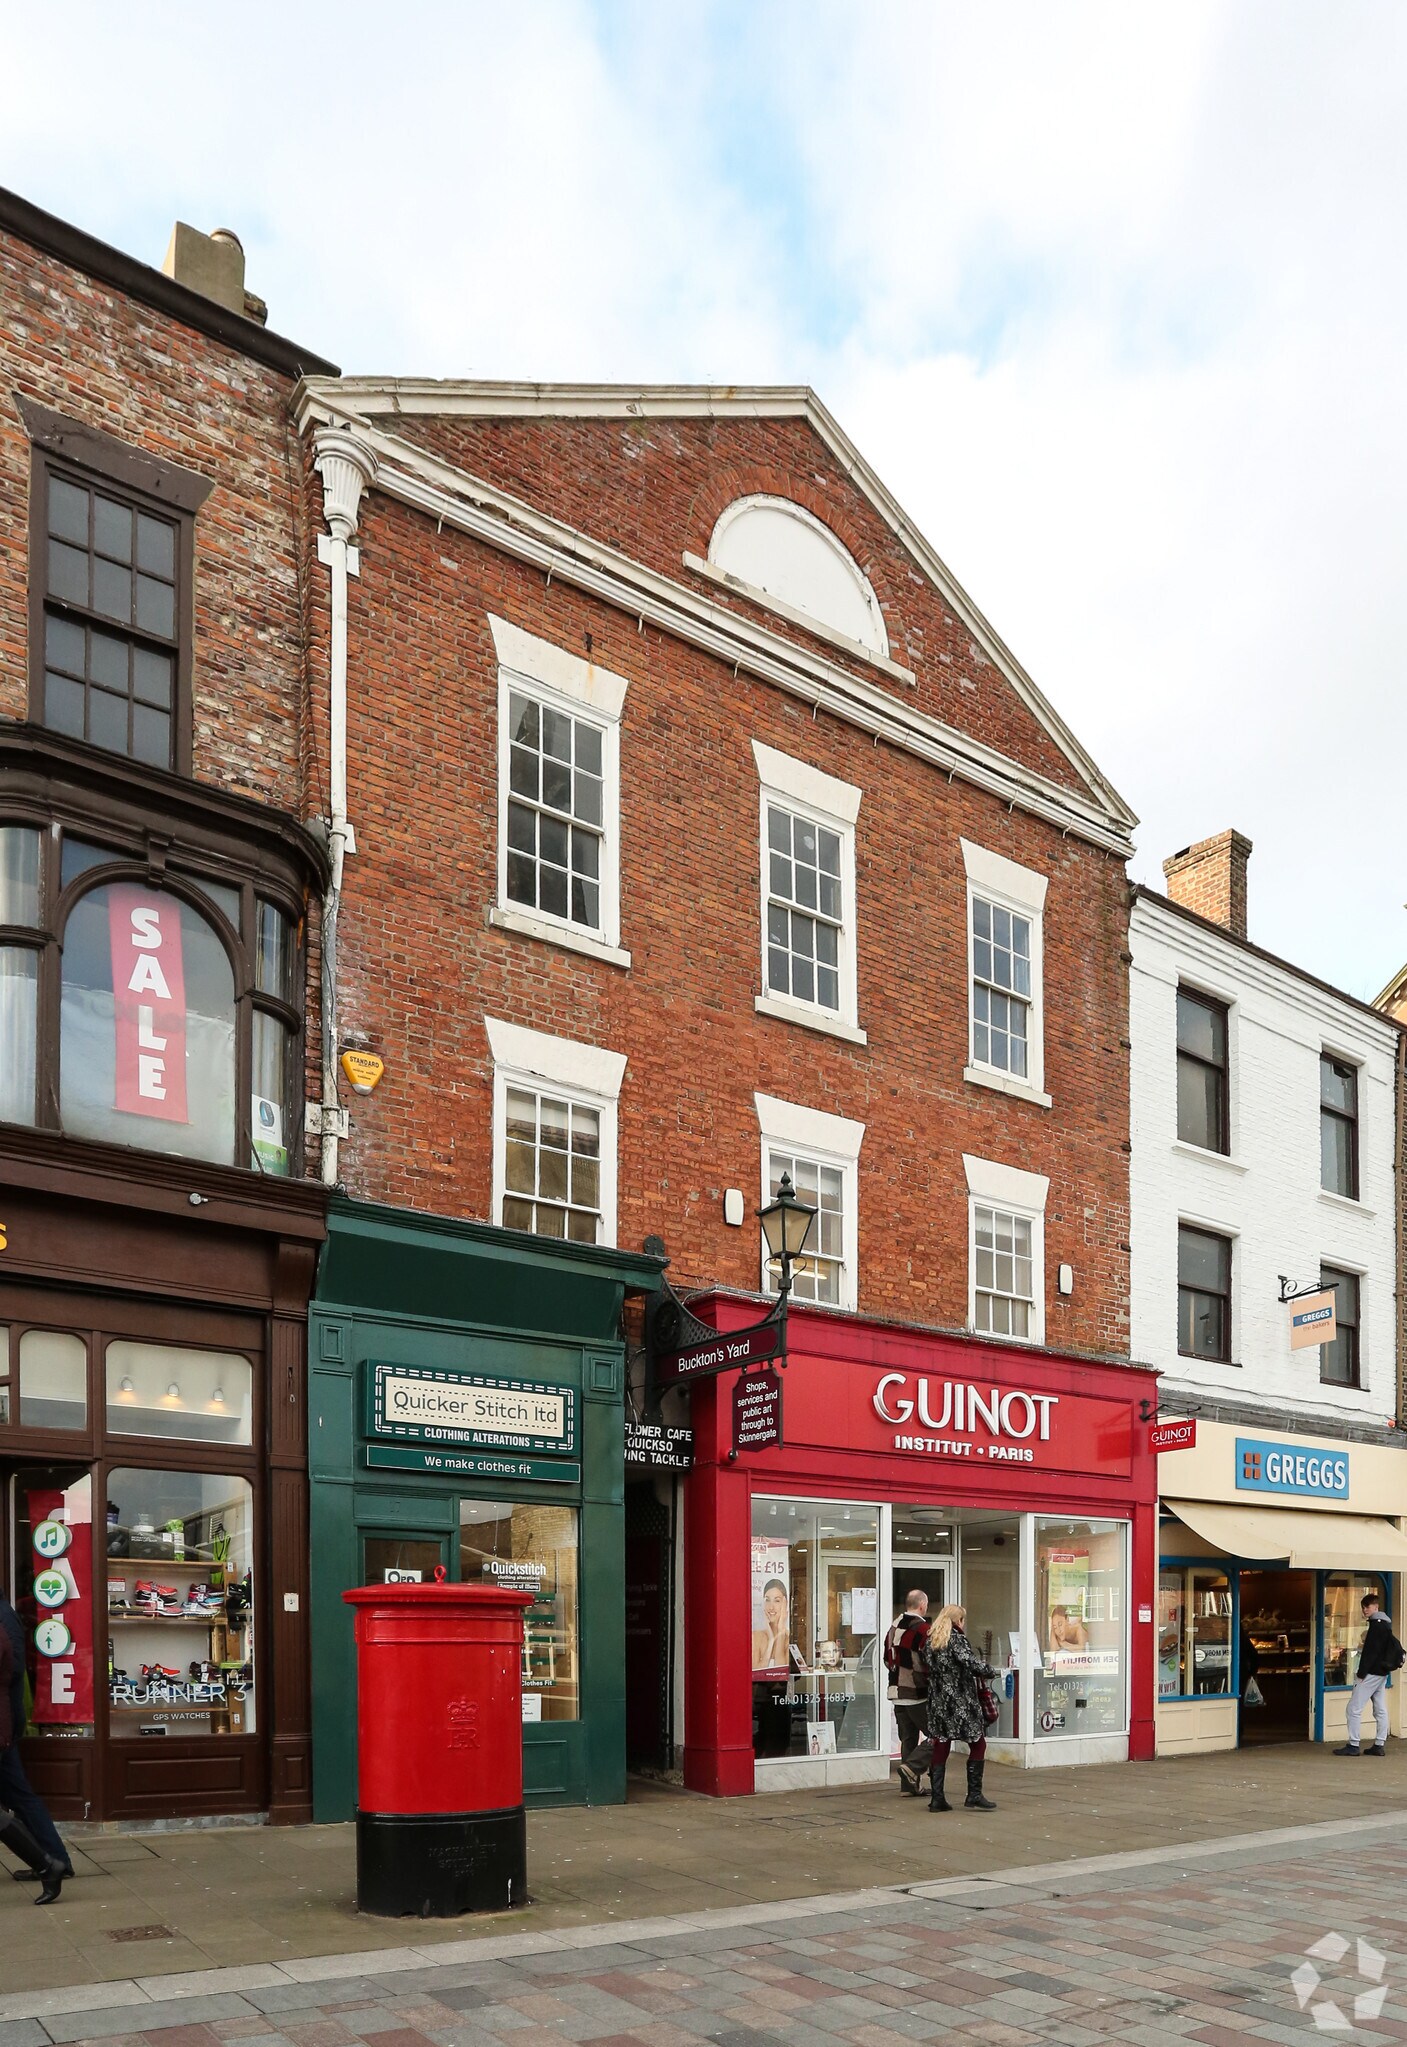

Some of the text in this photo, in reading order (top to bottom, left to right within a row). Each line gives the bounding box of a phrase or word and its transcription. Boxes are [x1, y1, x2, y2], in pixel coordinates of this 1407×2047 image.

[128, 908, 172, 1100] SALE
[350, 1056, 379, 1068] STANDARD
[1302, 1310, 1330, 1323] GREGGS
[678, 1340, 750, 1372] Buckton's Yard
[746, 1382, 768, 1392] Shops,
[737, 1390, 778, 1407] services and
[393, 1391, 558, 1423] Quicker Stitch ltd
[742, 1404, 772, 1420] public art
[873, 1373, 1059, 1441] GUINOT
[742, 1417, 774, 1430] through to
[424, 1427, 530, 1447] CLOTHING ALTERATIONS
[667, 1428, 692, 1441] CAFE
[738, 1430, 776, 1444] Skinnergate
[1151, 1426, 1192, 1442] GUINOT
[895, 1435, 1034, 1462] INSTITUT PARIS
[424, 1456, 532, 1474] We make clothes fit
[650, 1452, 690, 1467] TACKLE
[1266, 1452, 1346, 1490] GREGGS
[491, 1562, 546, 1576] Quickstitch
[764, 1560, 784, 1574] £15
[113, 1683, 226, 1705] RUNNER
[772, 1695, 789, 1705] Tel:
[793, 1694, 820, 1704] 01325
[171, 1712, 210, 1720] WATCHES
